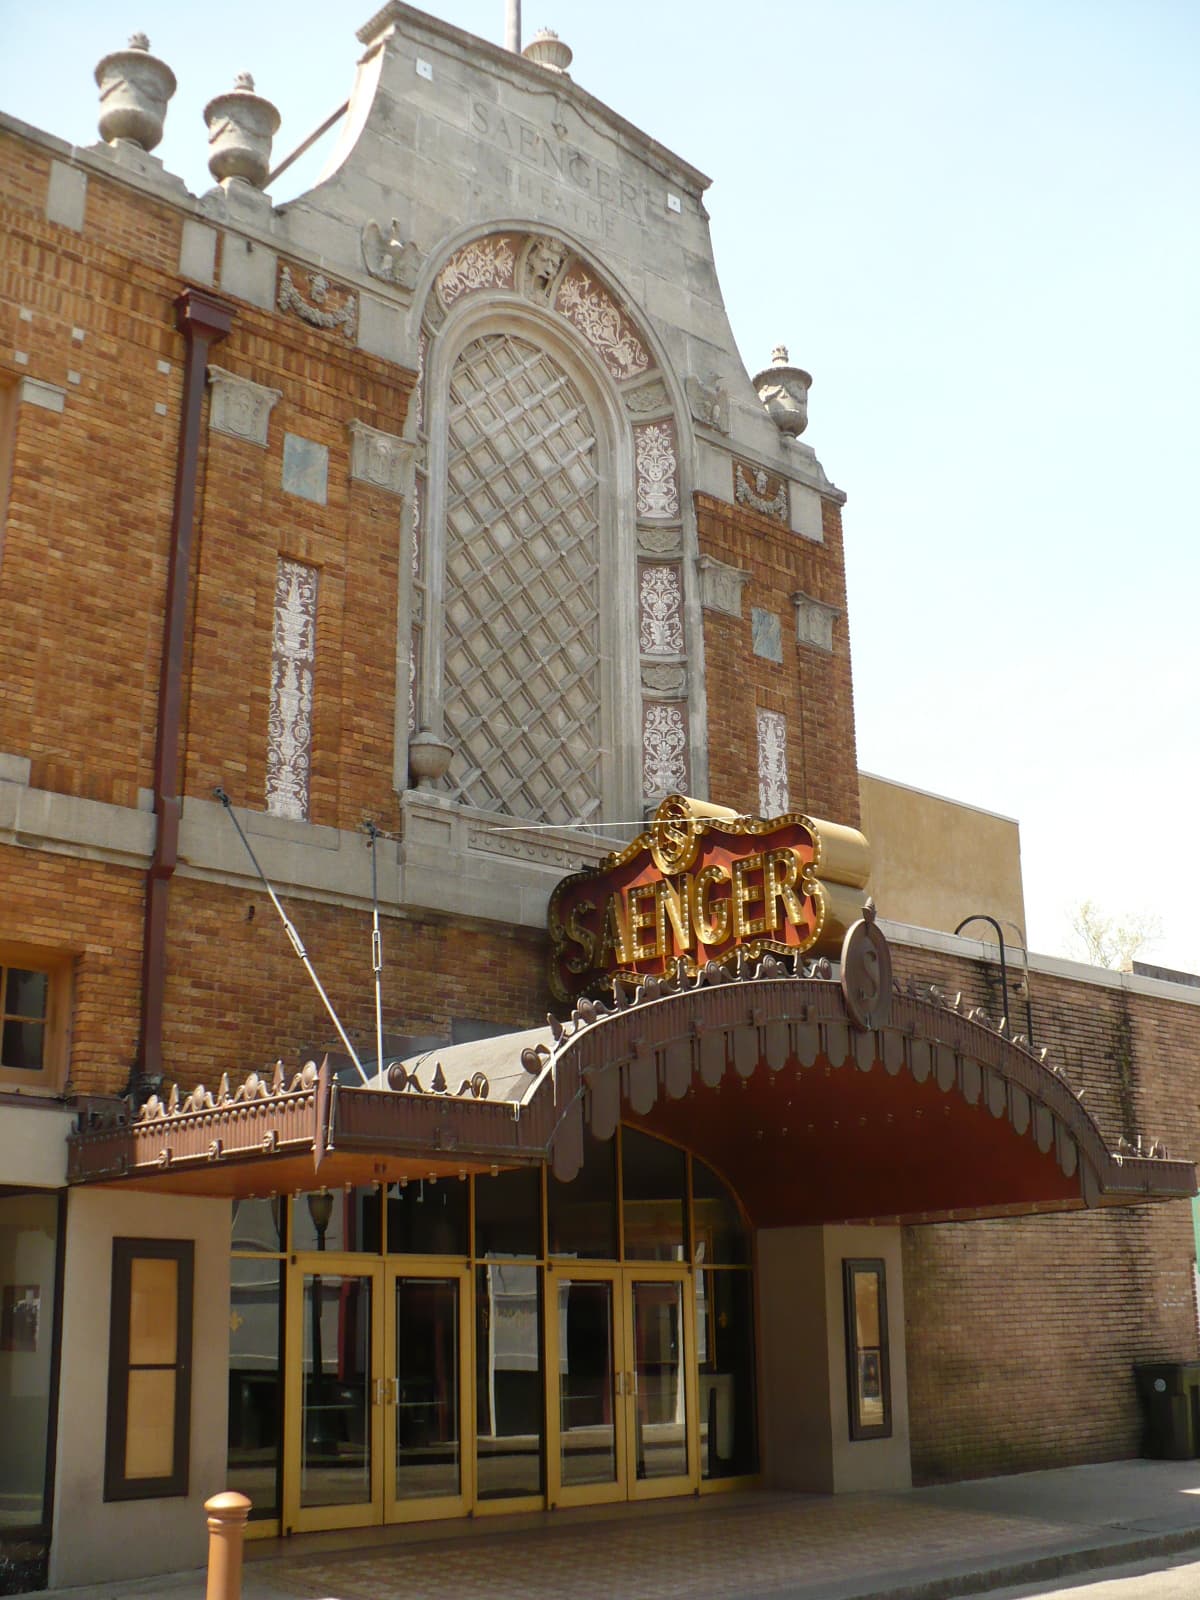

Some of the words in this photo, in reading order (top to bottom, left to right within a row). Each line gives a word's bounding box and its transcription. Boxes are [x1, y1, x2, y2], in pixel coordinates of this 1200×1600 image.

[471, 102, 643, 225] SAENGER
[663, 803, 688, 862] S
[564, 847, 805, 974] SAENGER
